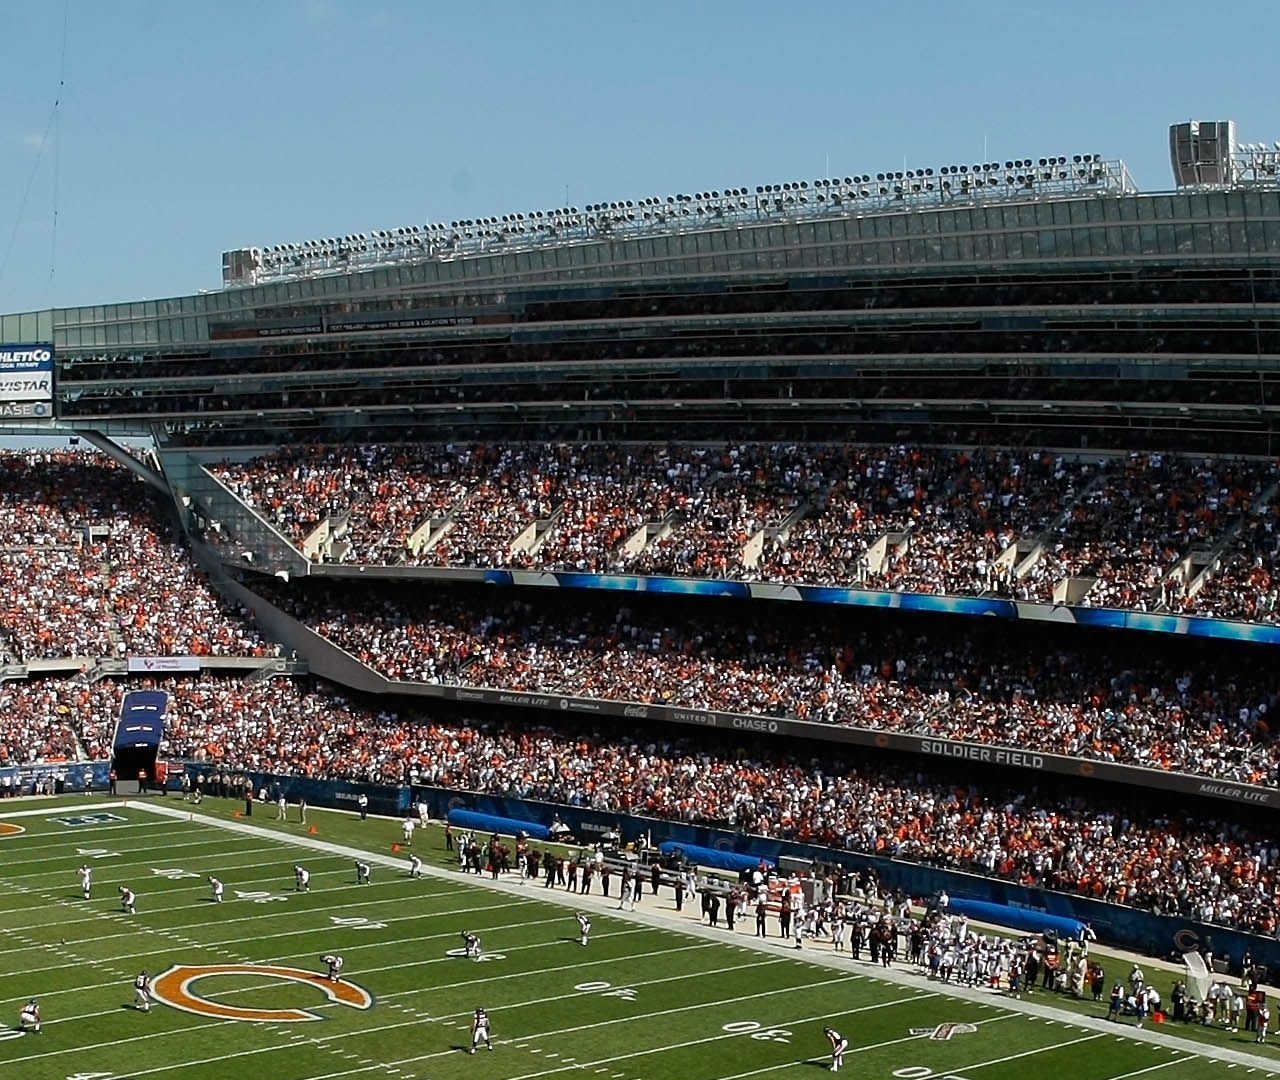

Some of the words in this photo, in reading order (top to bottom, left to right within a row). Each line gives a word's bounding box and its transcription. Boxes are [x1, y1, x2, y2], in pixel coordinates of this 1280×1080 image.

[499, 695, 530, 705] MILLER
[532, 697, 550, 707] LITE
[674, 713, 707, 724] UNITED
[732, 718, 768, 732] CHASE
[921, 741, 991, 763] SOLDIER
[995, 750, 1044, 770] FIELD
[1199, 784, 1243, 800] MILLER
[1244, 791, 1269, 803] LITE
[147, 963, 372, 1023] C
[721, 1020, 793, 1043] 30
